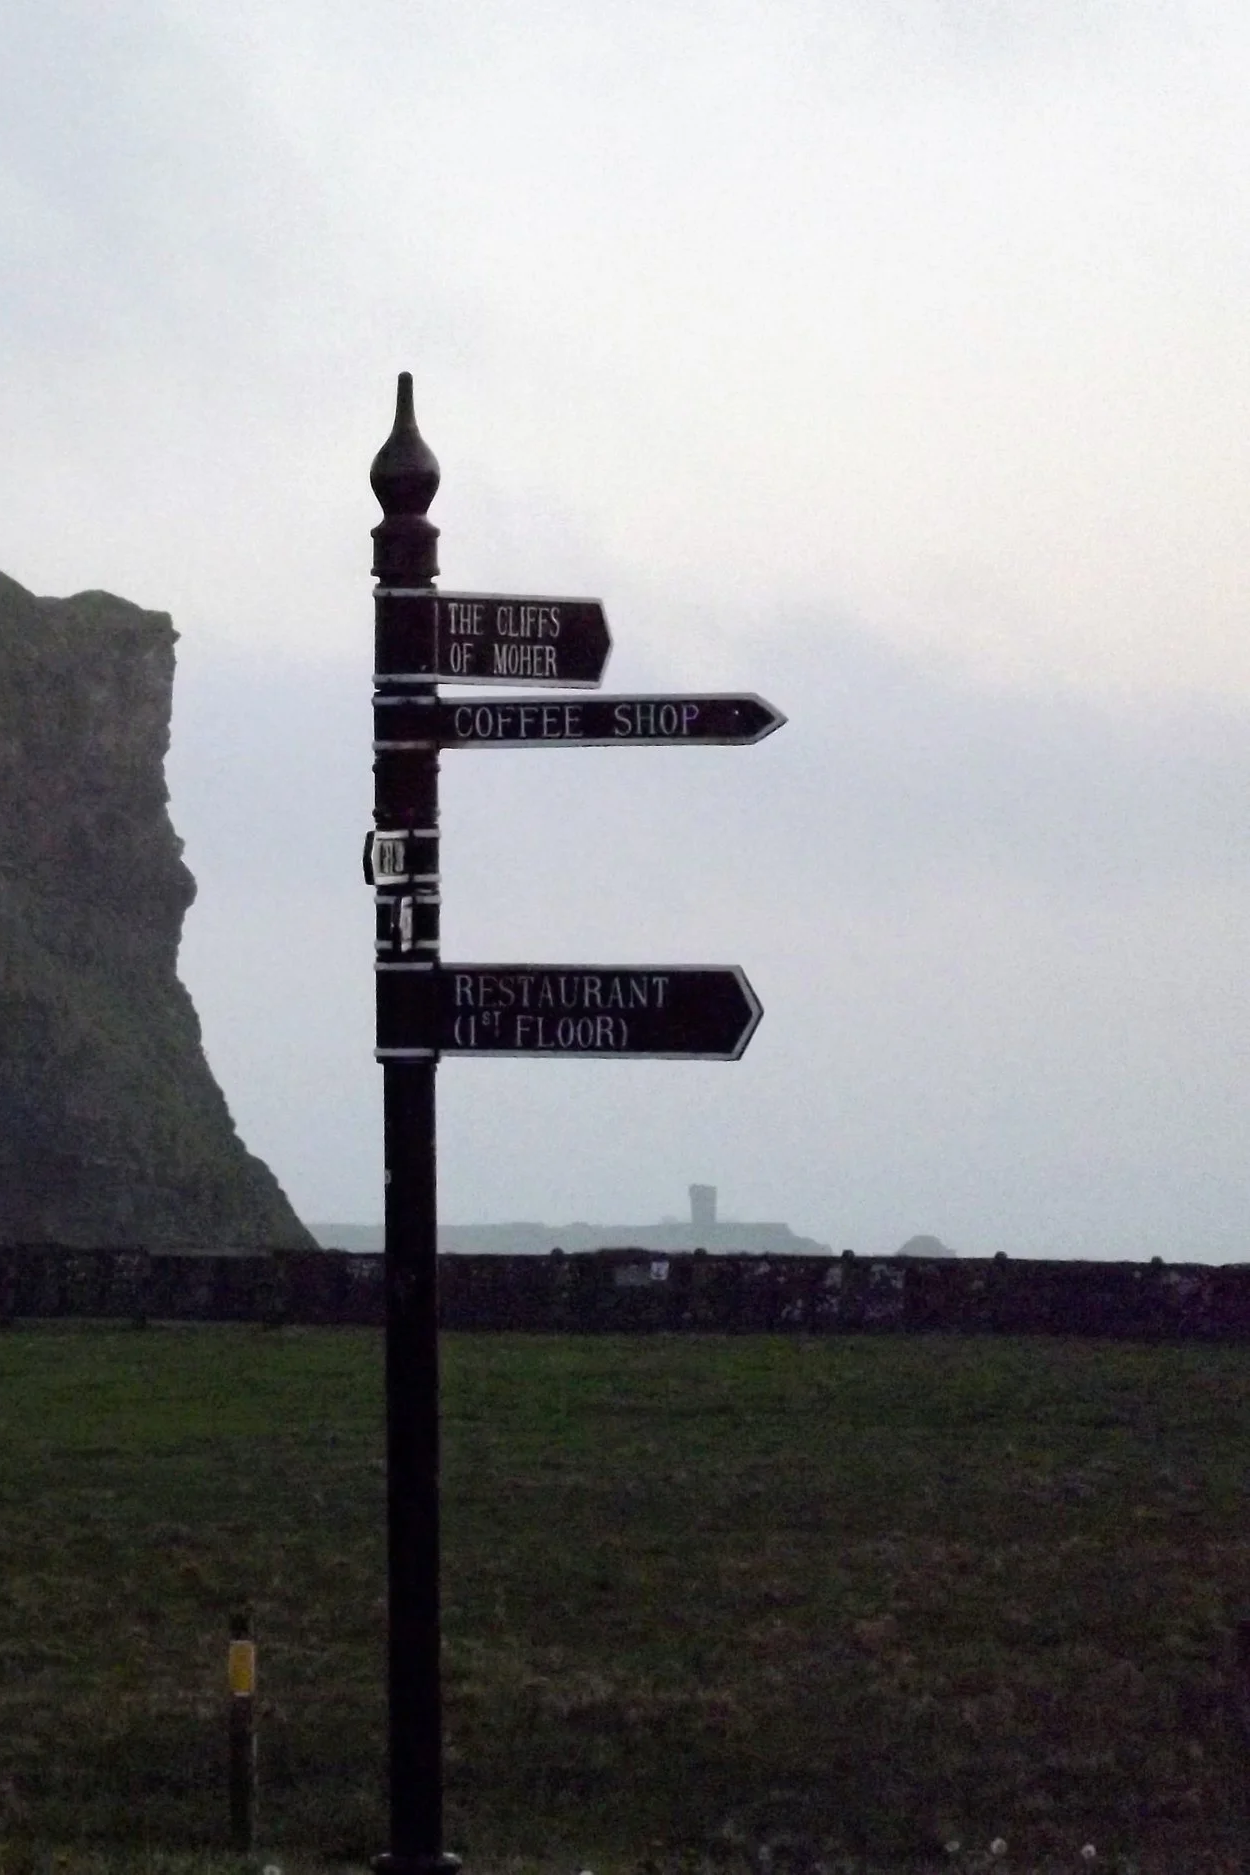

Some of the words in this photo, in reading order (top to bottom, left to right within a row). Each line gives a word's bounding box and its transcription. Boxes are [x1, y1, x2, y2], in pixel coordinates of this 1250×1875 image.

[449, 603, 484, 636] THE
[497, 606, 561, 638] CLIFFS
[450, 643, 473, 674] OF
[493, 645, 559, 677] MOHER
[454, 706, 584, 738] COFFEE
[614, 704, 700, 736] SHOP
[454, 974, 670, 1009] RESTAURANT
[515, 1015, 629, 1049] FLOOR)
